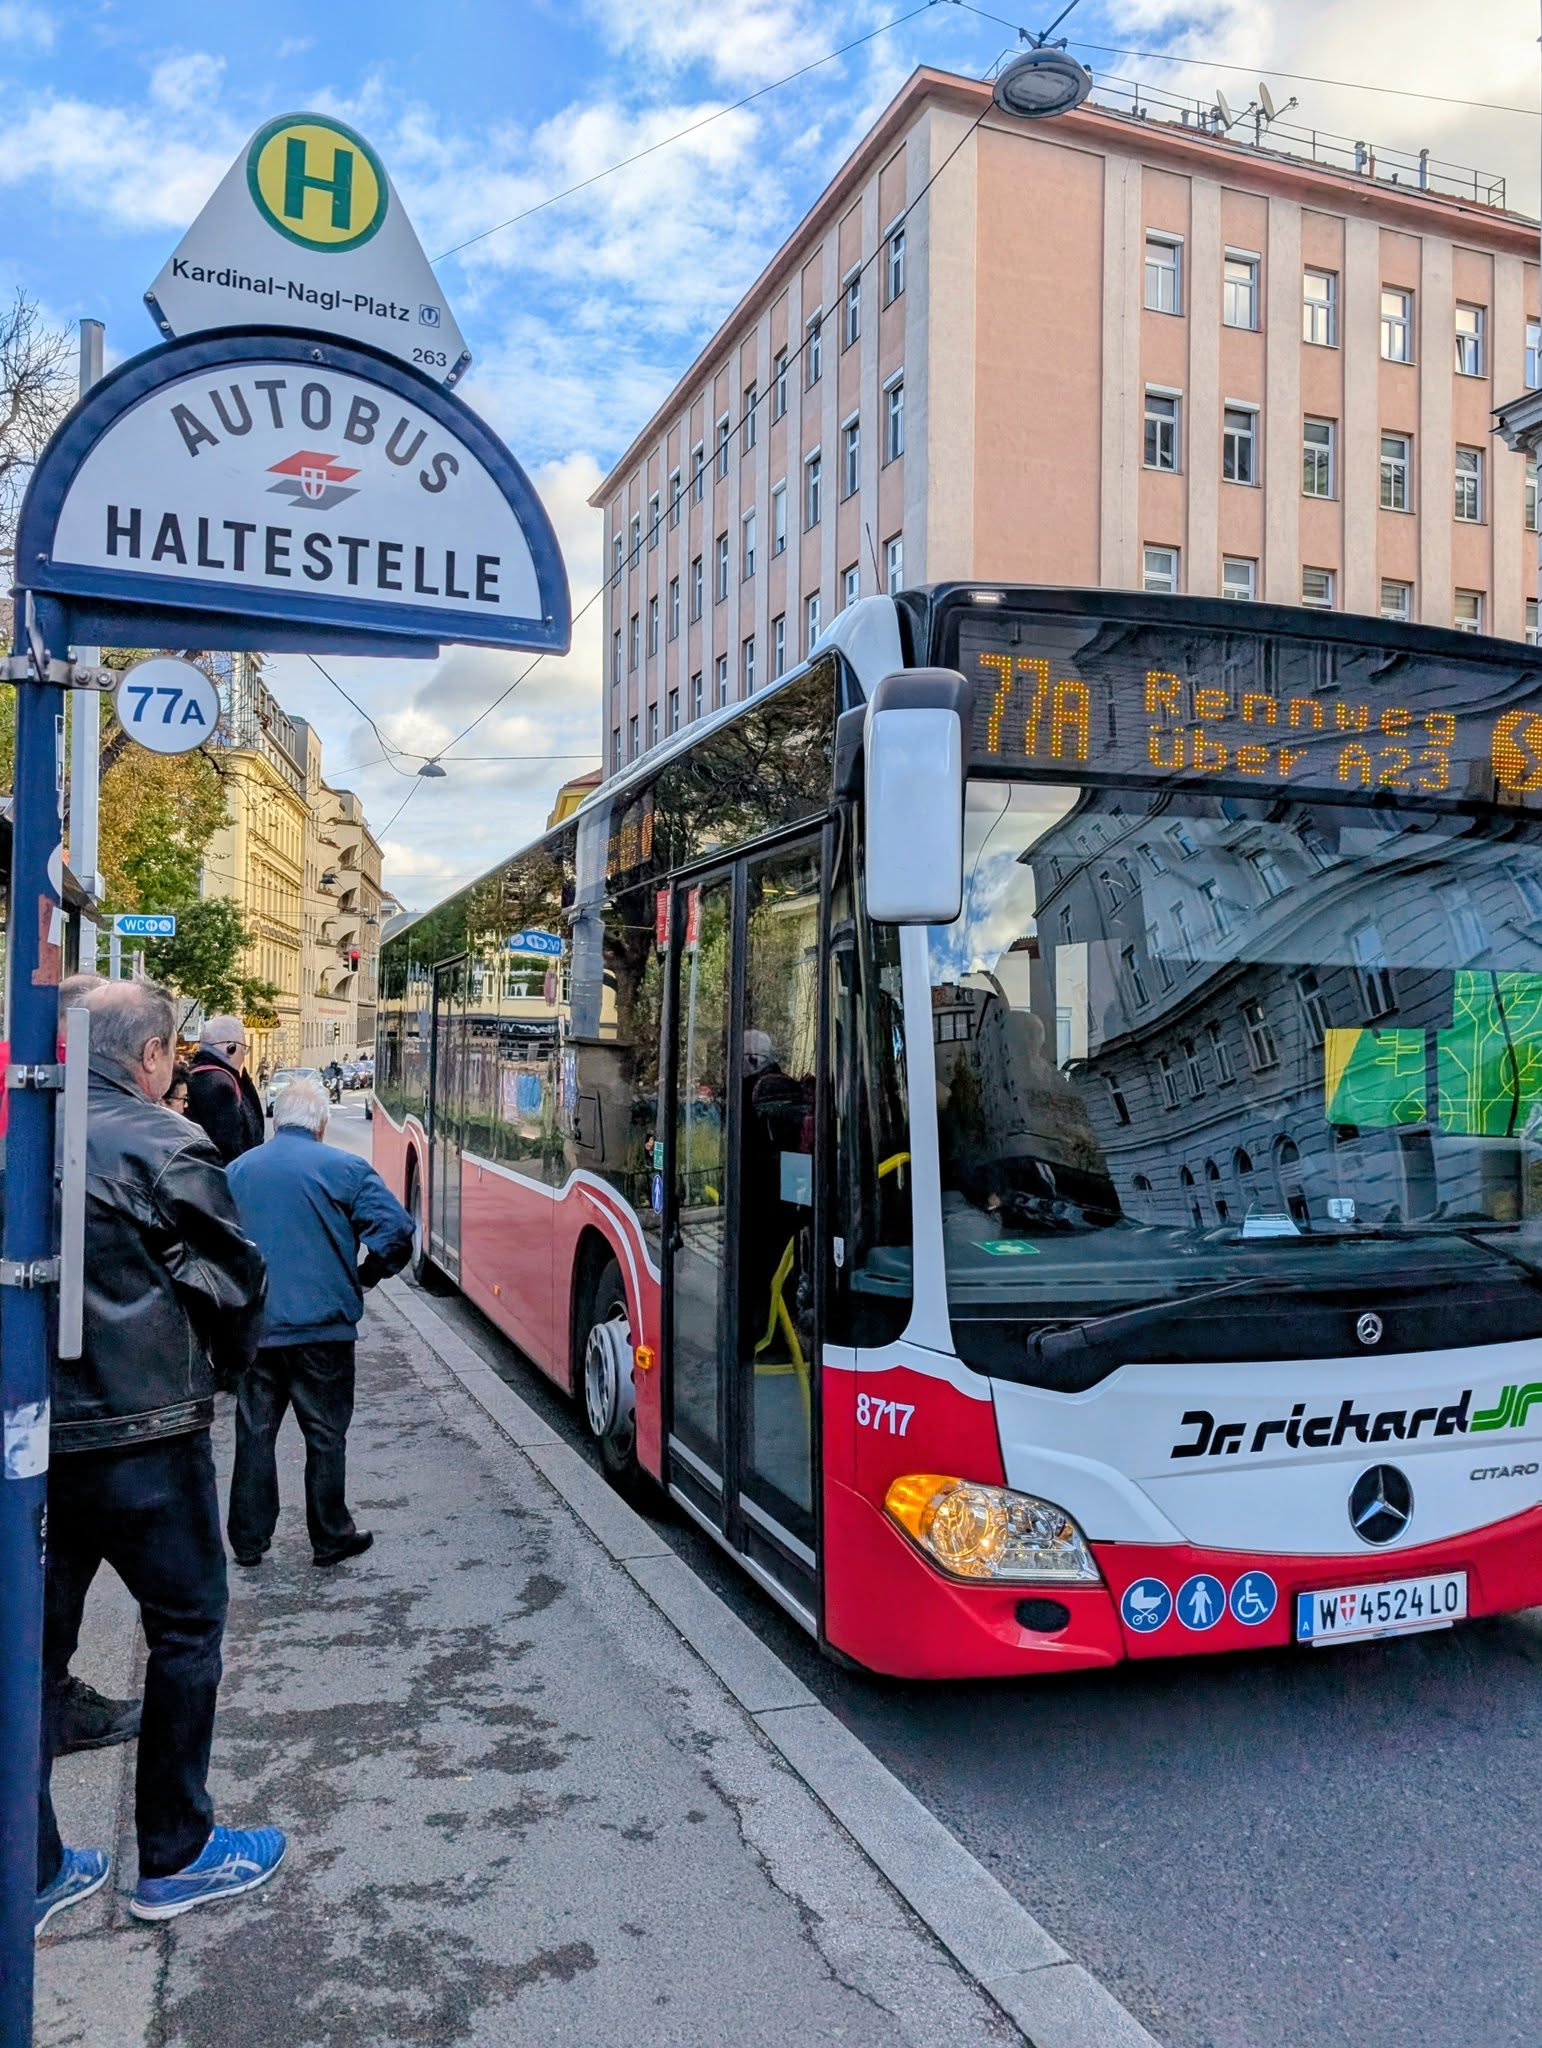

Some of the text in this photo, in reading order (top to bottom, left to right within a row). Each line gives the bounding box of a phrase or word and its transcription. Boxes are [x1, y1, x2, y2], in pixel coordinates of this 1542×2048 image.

[284, 137, 353, 230] H
[172, 258, 410, 322] Kardinal-Nagl-Platz
[412, 347, 447, 367] 263
[170, 379, 460, 494] AUTOBUS
[106, 505, 500, 603] HALTESTELLE
[126, 686, 206, 726] 77A
[979, 653, 1456, 760] 77A Rennweg
[1338, 742, 1450, 789] A23
[124, 919, 145, 931] WC
[856, 1392, 915, 1437] 8717
[1469, 1462, 1540, 1481] CITARO
[1302, 1621, 1310, 1631] A
[1319, 1597, 1338, 1630] W
